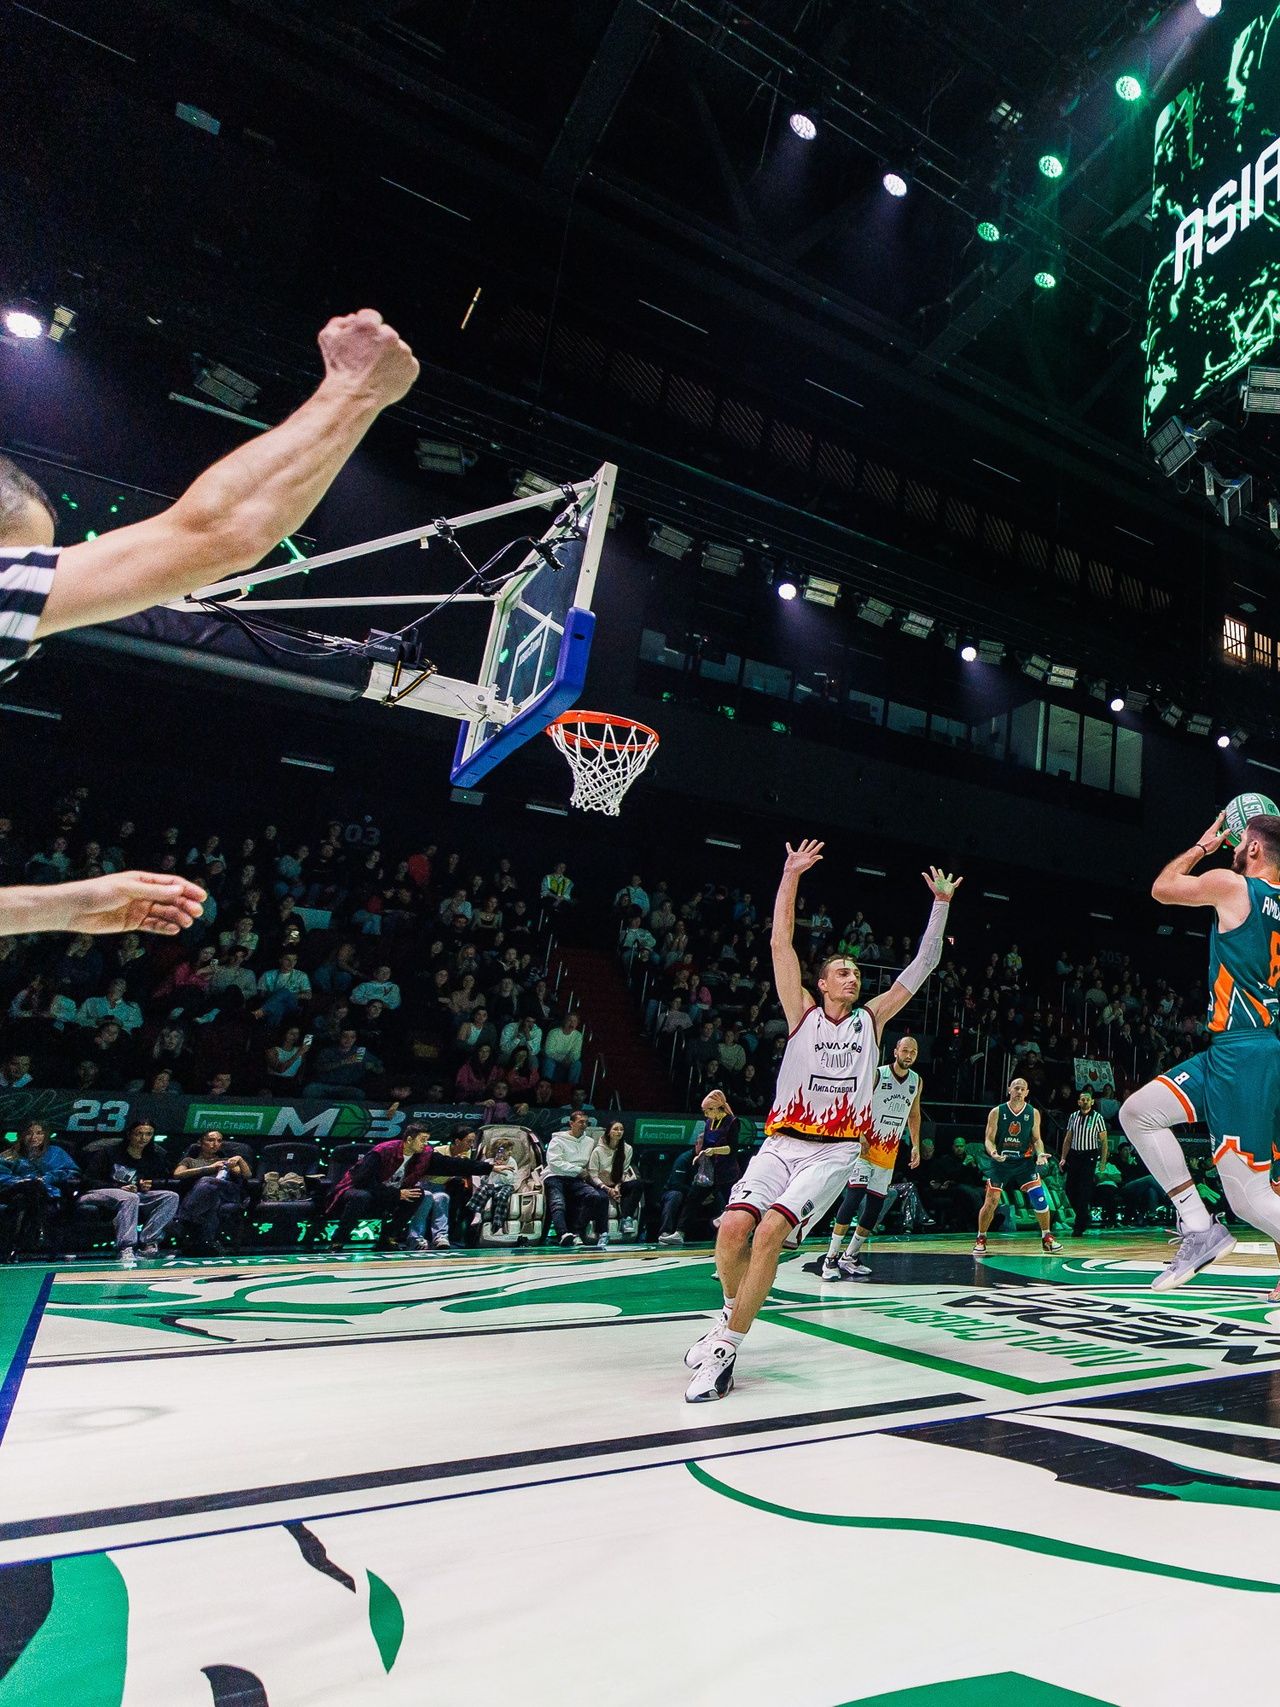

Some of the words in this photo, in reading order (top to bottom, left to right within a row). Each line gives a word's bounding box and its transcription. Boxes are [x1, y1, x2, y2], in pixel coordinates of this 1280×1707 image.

[1173, 1071, 1191, 1086] 8
[812, 1083, 829, 1093] ЛИГА
[829, 1085, 853, 1093] СТАВОК
[881, 1082, 893, 1090] 25
[66, 1099, 130, 1132] 23
[413, 1110, 463, 1119] ВТОРОЙ
[741, 1190, 752, 1200] 7
[860, 1304, 1041, 1342] СТАВОК
[1007, 1335, 1170, 1367] ЛИГА
